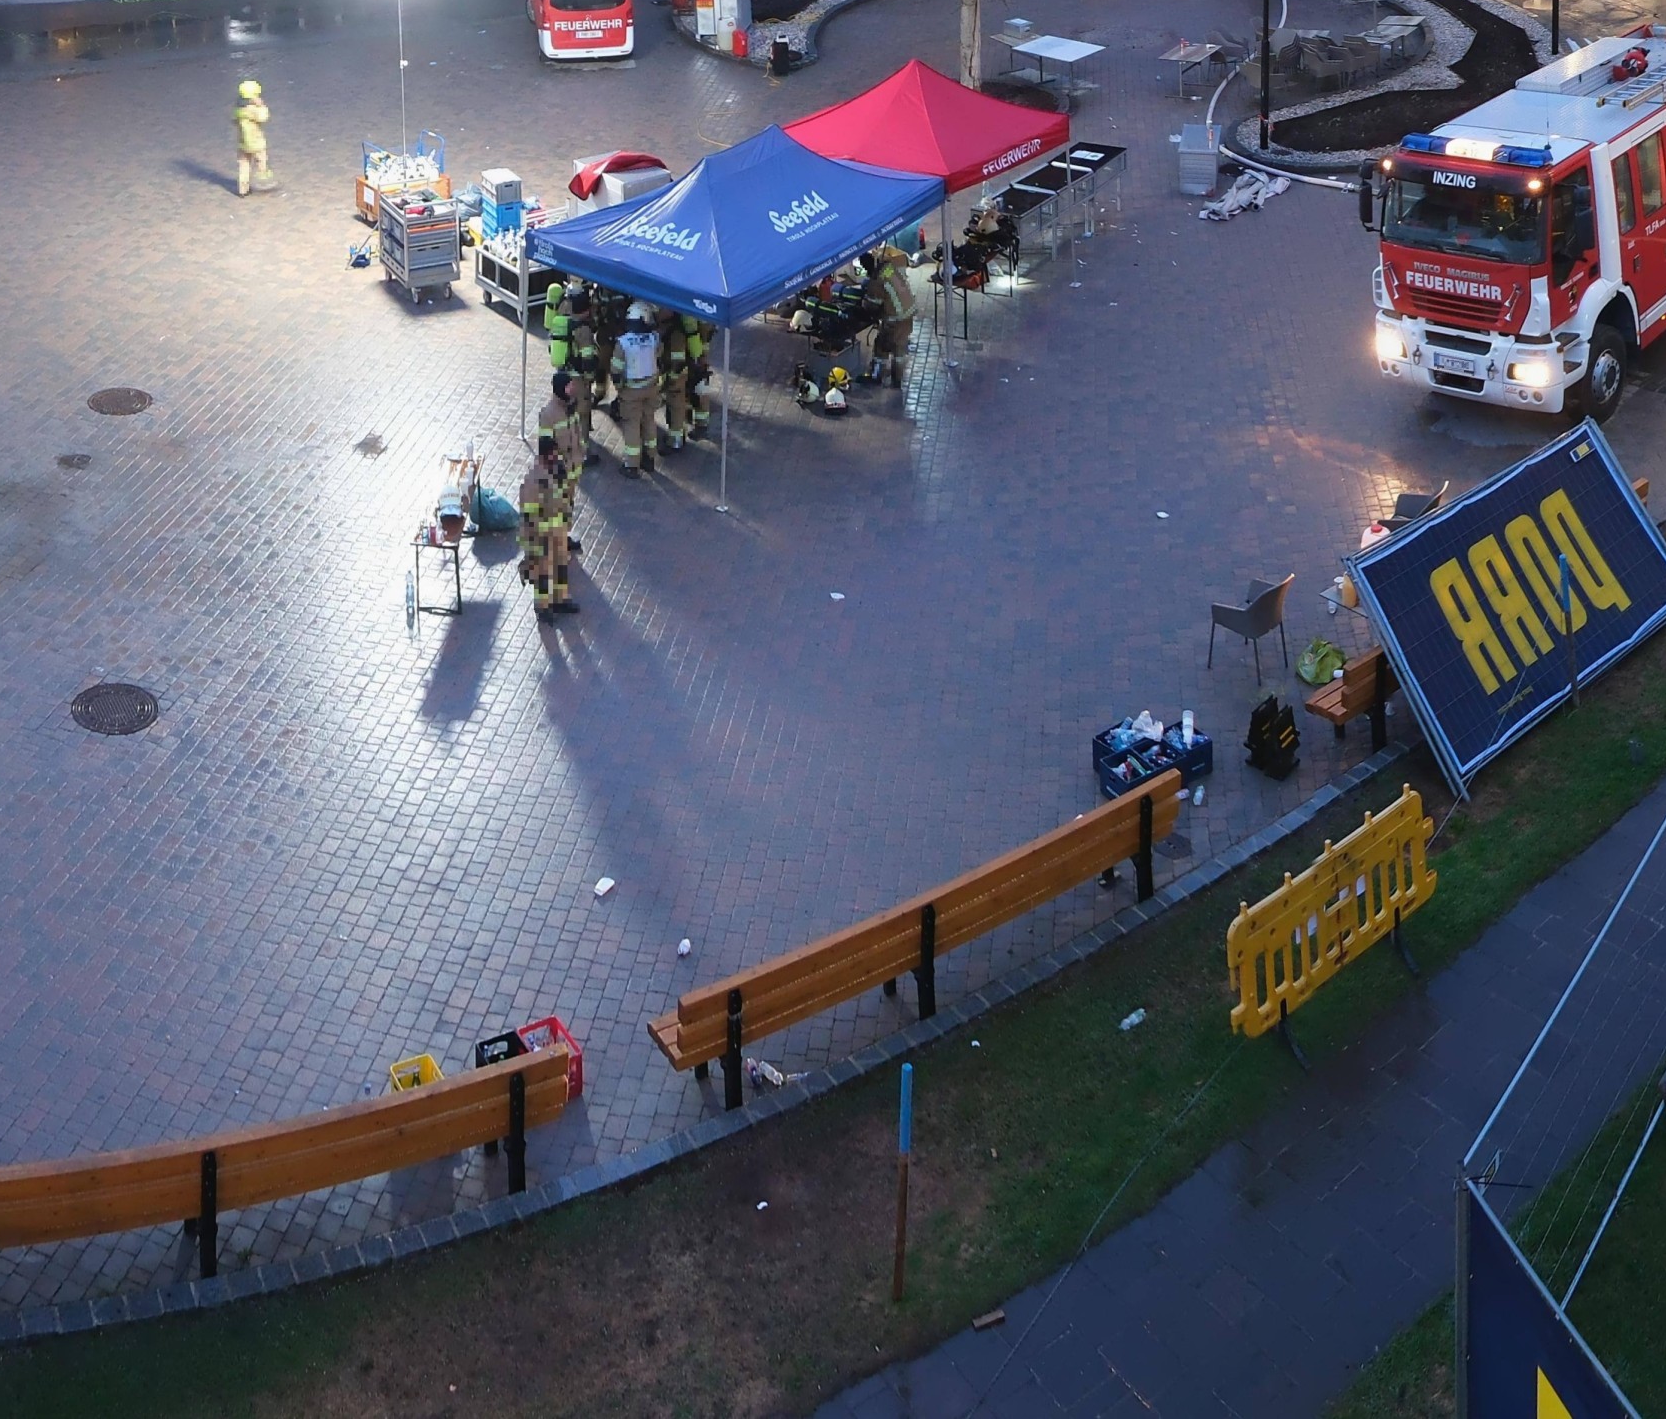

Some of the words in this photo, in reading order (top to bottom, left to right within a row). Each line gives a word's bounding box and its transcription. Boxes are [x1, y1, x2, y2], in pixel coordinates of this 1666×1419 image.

[554, 18, 623, 31] FEUERWEHR
[983, 138, 1041, 175] FEUERWEHR
[1433, 171, 1476, 189] INZING
[768, 190, 829, 234] Seefeld
[620, 216, 702, 252] Seefeld
[786, 231, 806, 243] TIROLS
[805, 212, 840, 235] HOCHPLATEAU
[1645, 219, 1660, 236] TLFA
[636, 243, 684, 261] HOCHPLATEAU
[1414, 261, 1440, 274] IVECO
[1446, 267, 1490, 282] MAGIRUS
[1406, 271, 1502, 301] FEUERWEHR
